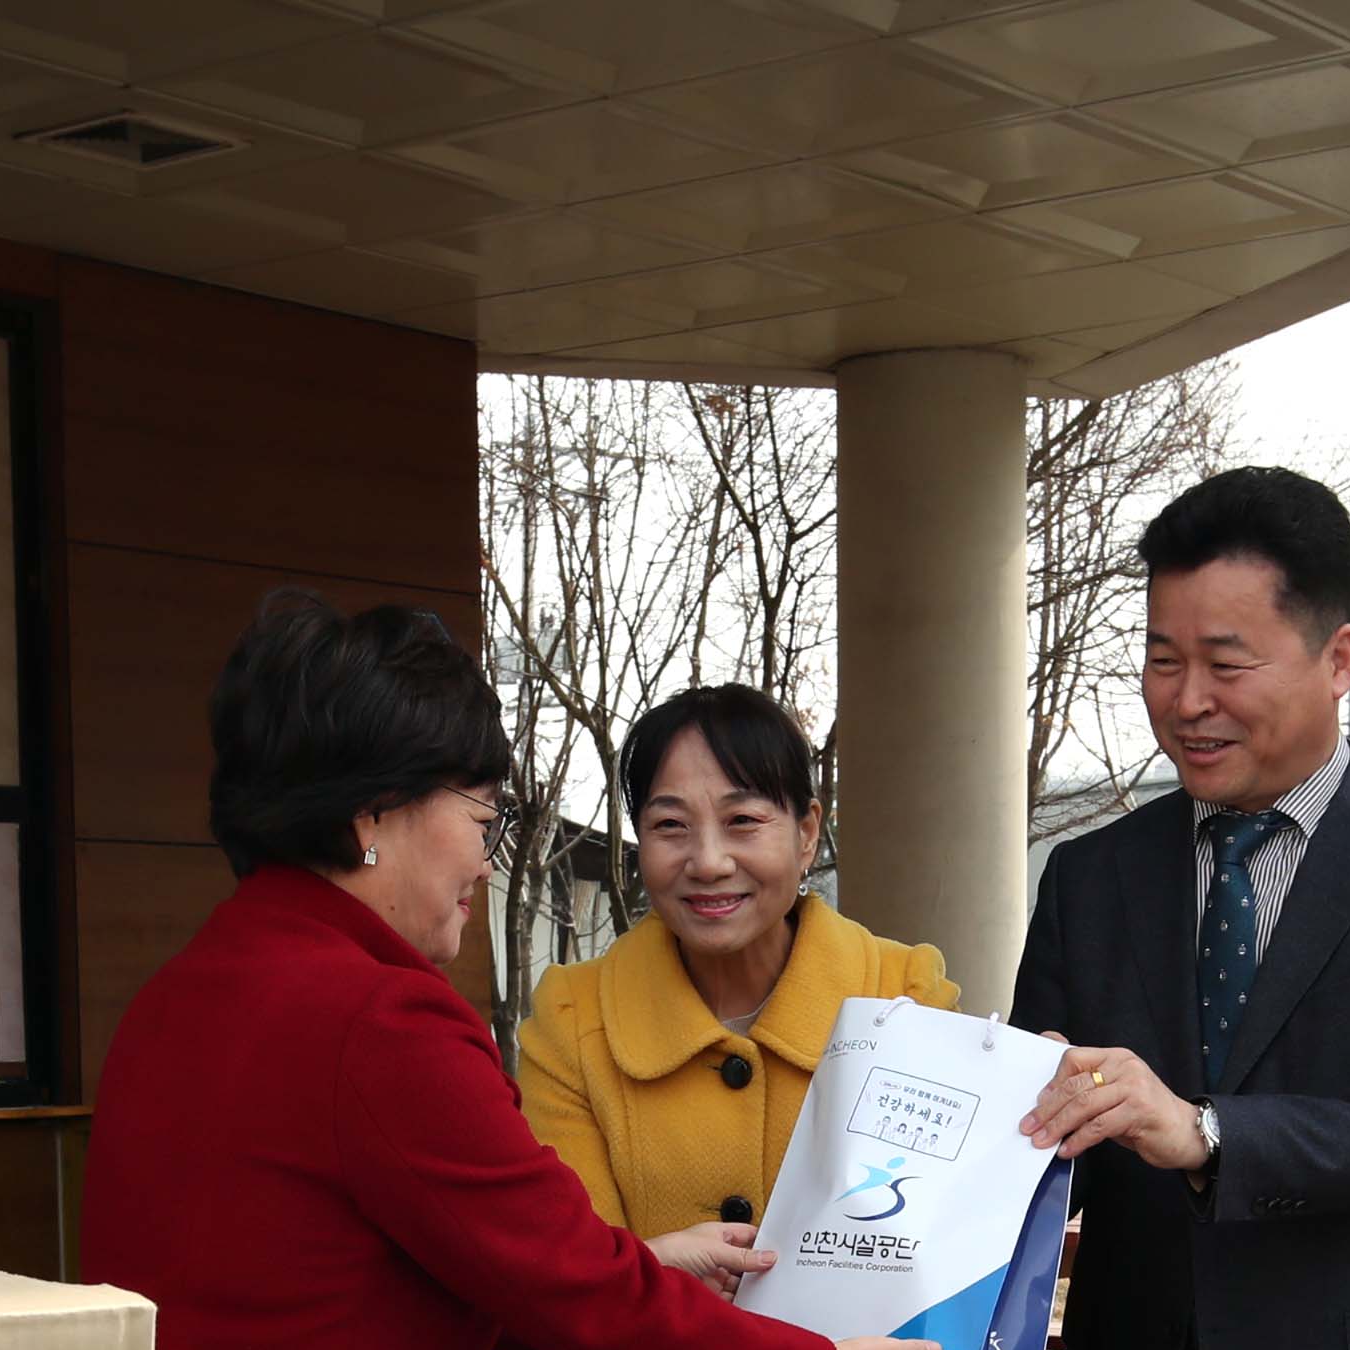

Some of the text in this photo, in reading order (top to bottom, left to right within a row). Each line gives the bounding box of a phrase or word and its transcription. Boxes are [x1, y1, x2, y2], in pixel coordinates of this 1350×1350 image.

[877, 1094, 952, 1128] 건강하세요!
[800, 1231, 921, 1259] 인천시설공단
[796, 1259, 913, 1273] Incheon Facilities Corporation
